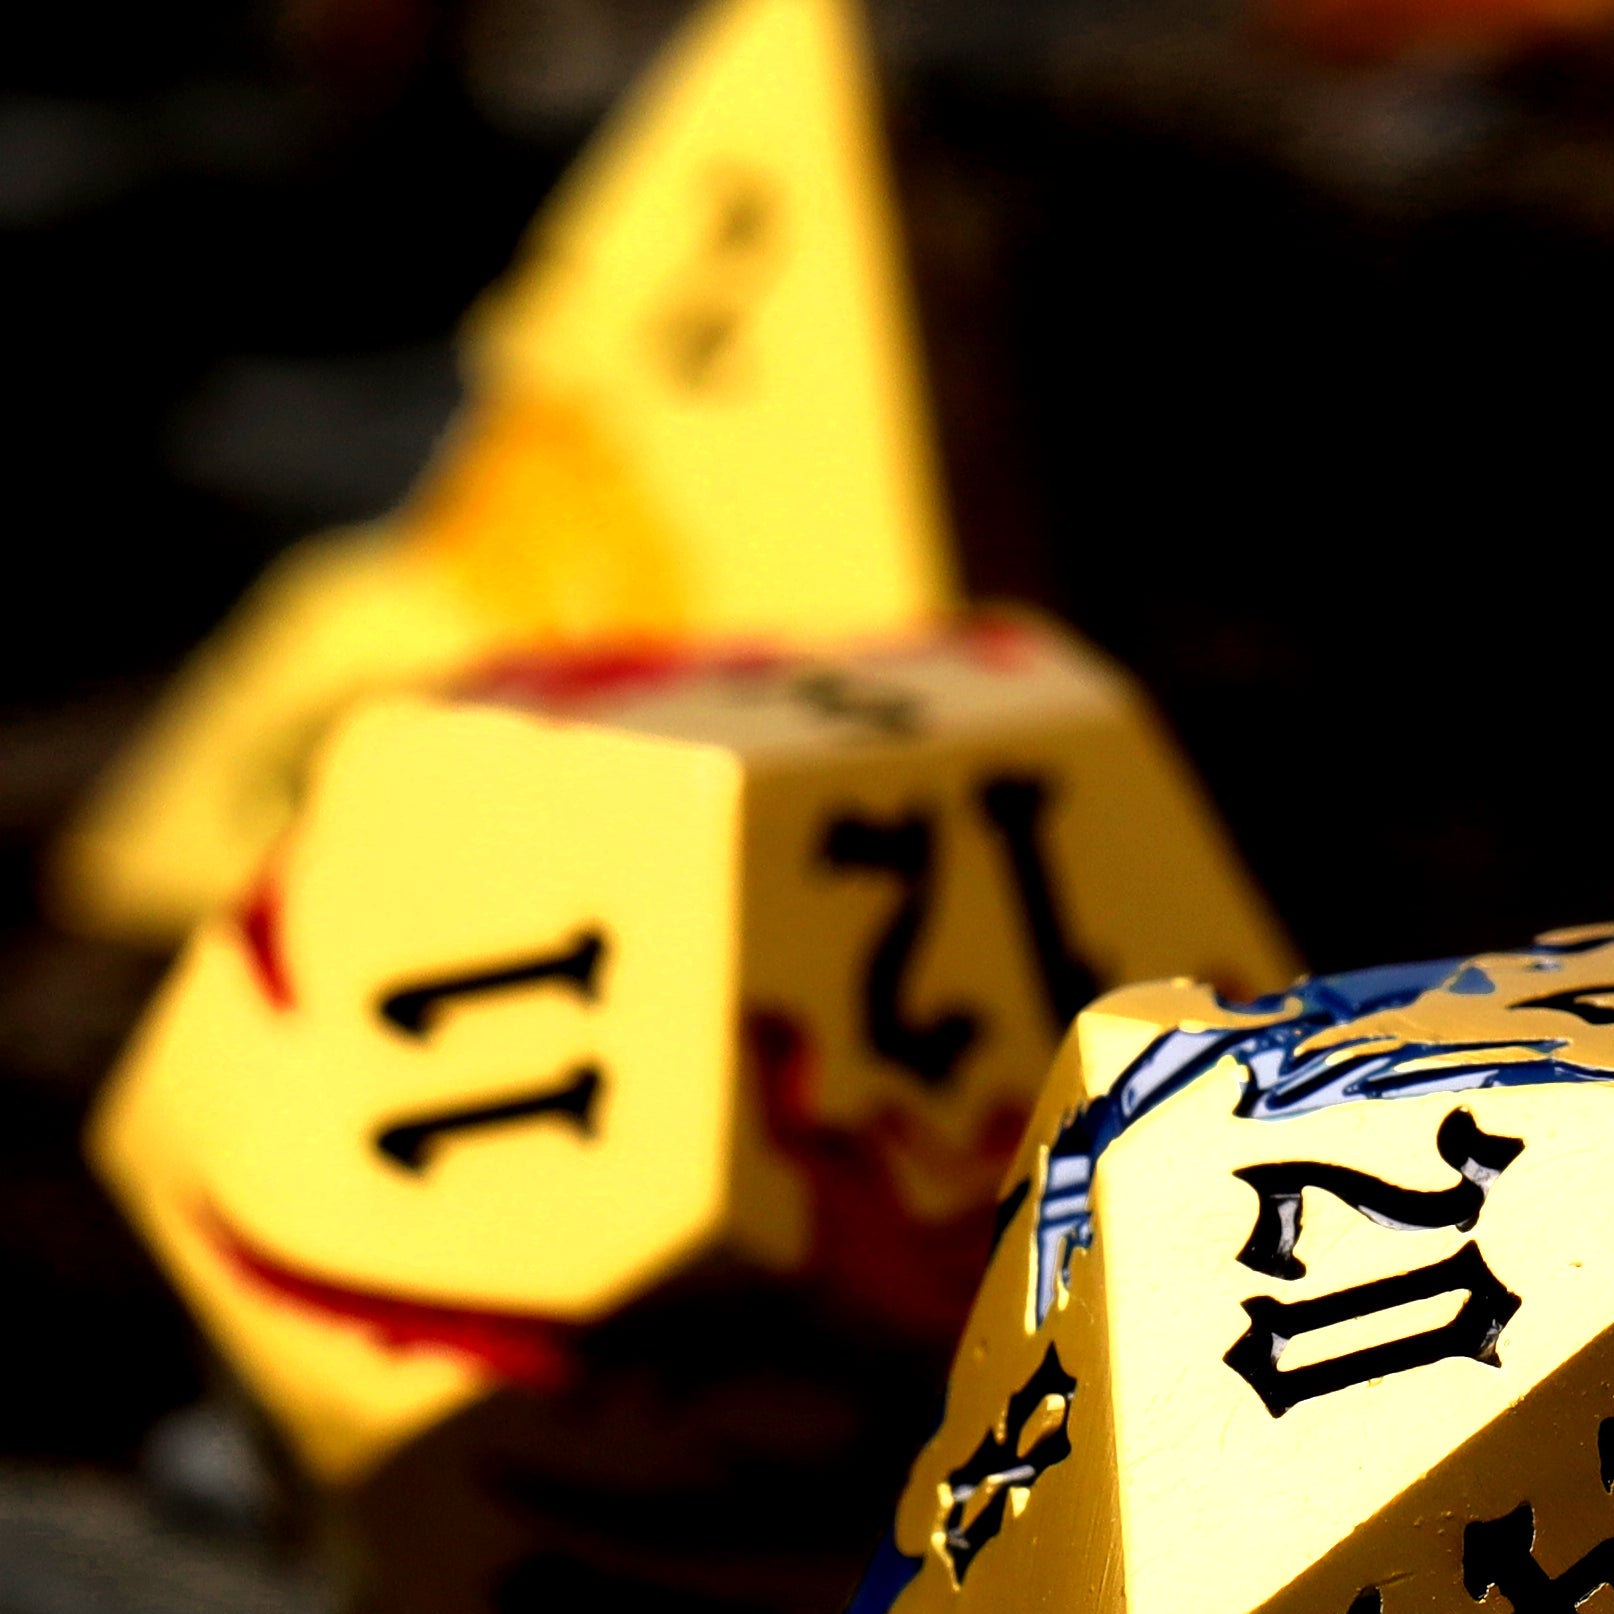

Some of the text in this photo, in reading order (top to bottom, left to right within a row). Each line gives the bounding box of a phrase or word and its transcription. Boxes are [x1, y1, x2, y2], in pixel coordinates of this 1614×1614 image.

[376, 930, 607, 1176] 11
[826, 780, 1103, 1078] 12
[1222, 1105, 1525, 1418] 20
[938, 1340, 1077, 1590] 8
